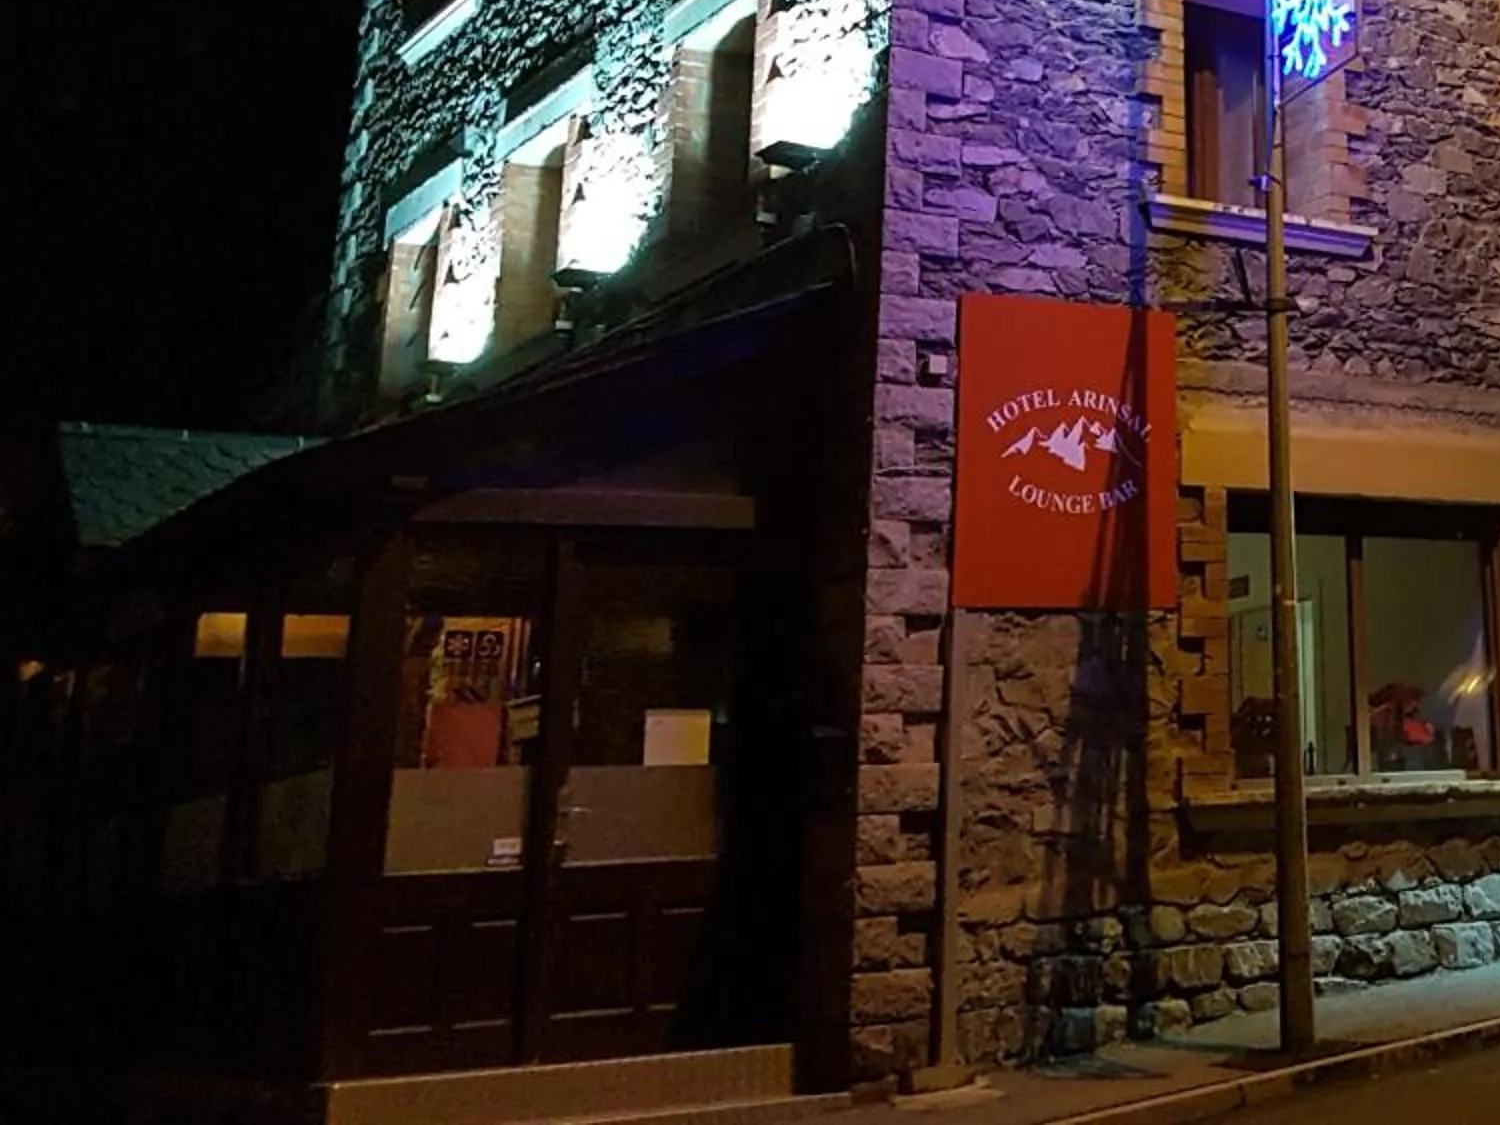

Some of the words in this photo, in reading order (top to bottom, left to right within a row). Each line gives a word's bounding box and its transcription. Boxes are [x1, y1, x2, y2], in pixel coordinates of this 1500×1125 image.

[986, 388, 1061, 433] HOTEL
[1008, 474, 1095, 515] LOUNGE
[1099, 478, 1139, 511] BAR
